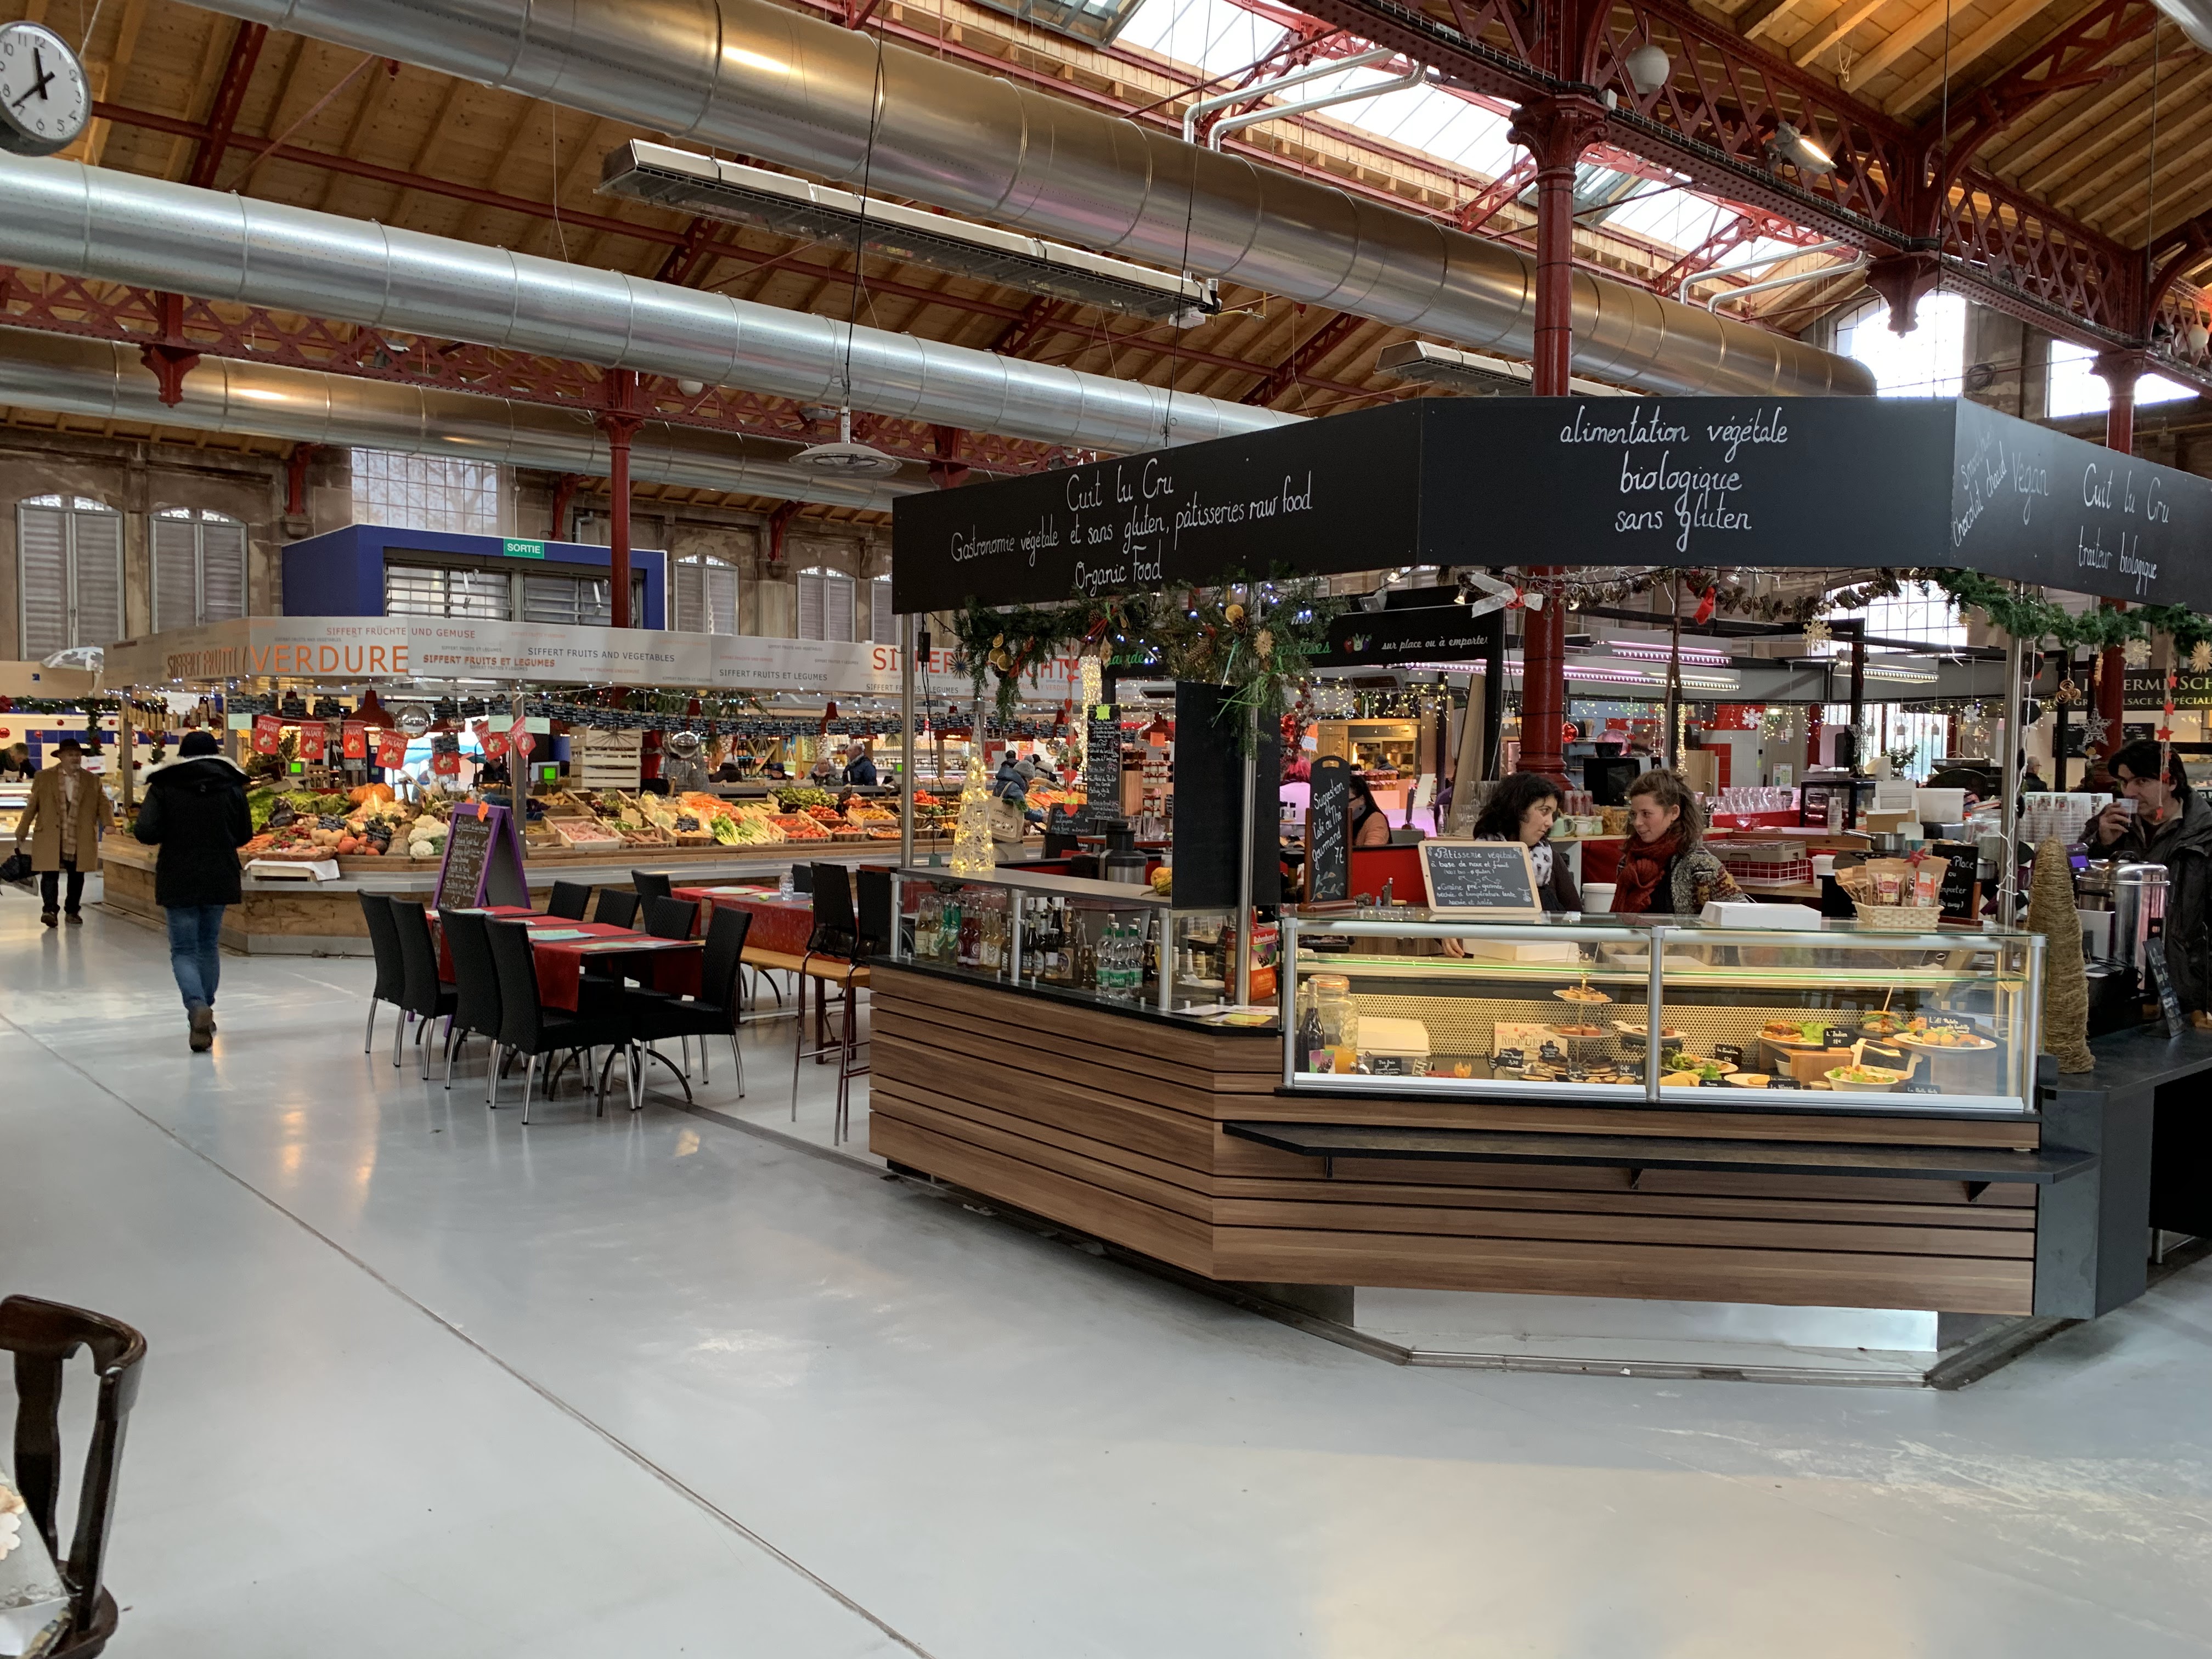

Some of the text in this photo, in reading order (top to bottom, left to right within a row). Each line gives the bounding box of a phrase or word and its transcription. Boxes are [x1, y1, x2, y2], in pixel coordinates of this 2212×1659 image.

[1560, 405, 1788, 463] alimentation végétale
[1066, 458, 1174, 511] Cuit lu Cru
[1620, 450, 1743, 516] biologique
[1953, 441, 2049, 547] Chocolat chaud Vegan
[2083, 463, 2169, 523] Cuit lu Cru
[951, 524, 1015, 561] Gastronomie
[1020, 513, 1059, 567] végétale
[1070, 514, 1081, 545] et
[1087, 523, 1113, 545] sans
[1174, 491, 1245, 550] pâtisseries
[1249, 495, 1278, 520] raw
[1283, 470, 1313, 514] food
[1615, 492, 1752, 552] sans gluten
[507, 543, 541, 555] SORTIE
[2079, 526, 2157, 596] traiteur biologique
[1075, 539, 1163, 597] Organic Food
[327, 627, 362, 636] SIFFERT
[411, 628, 432, 636] UND
[1398, 639, 1422, 652] place
[1439, 636, 1446, 646] à
[250, 645, 409, 673] VERDURE
[423, 654, 555, 668] SIFFERT FRUITS ET LEGUMES
[528, 647, 675, 662] SIFFERT FRUITS AND VEGETABLES
[719, 669, 751, 678] SIFFERT
[753, 670, 780, 679] FRUITS
[866, 683, 894, 691] SIFFERT
[1313, 778, 1345, 816] Suggestion
[1313, 806, 1342, 840] Café ou Thé
[1334, 847, 1344, 864] 7€
[1953, 855, 1974, 870] Place
[1939, 884, 1967, 895] mporter
